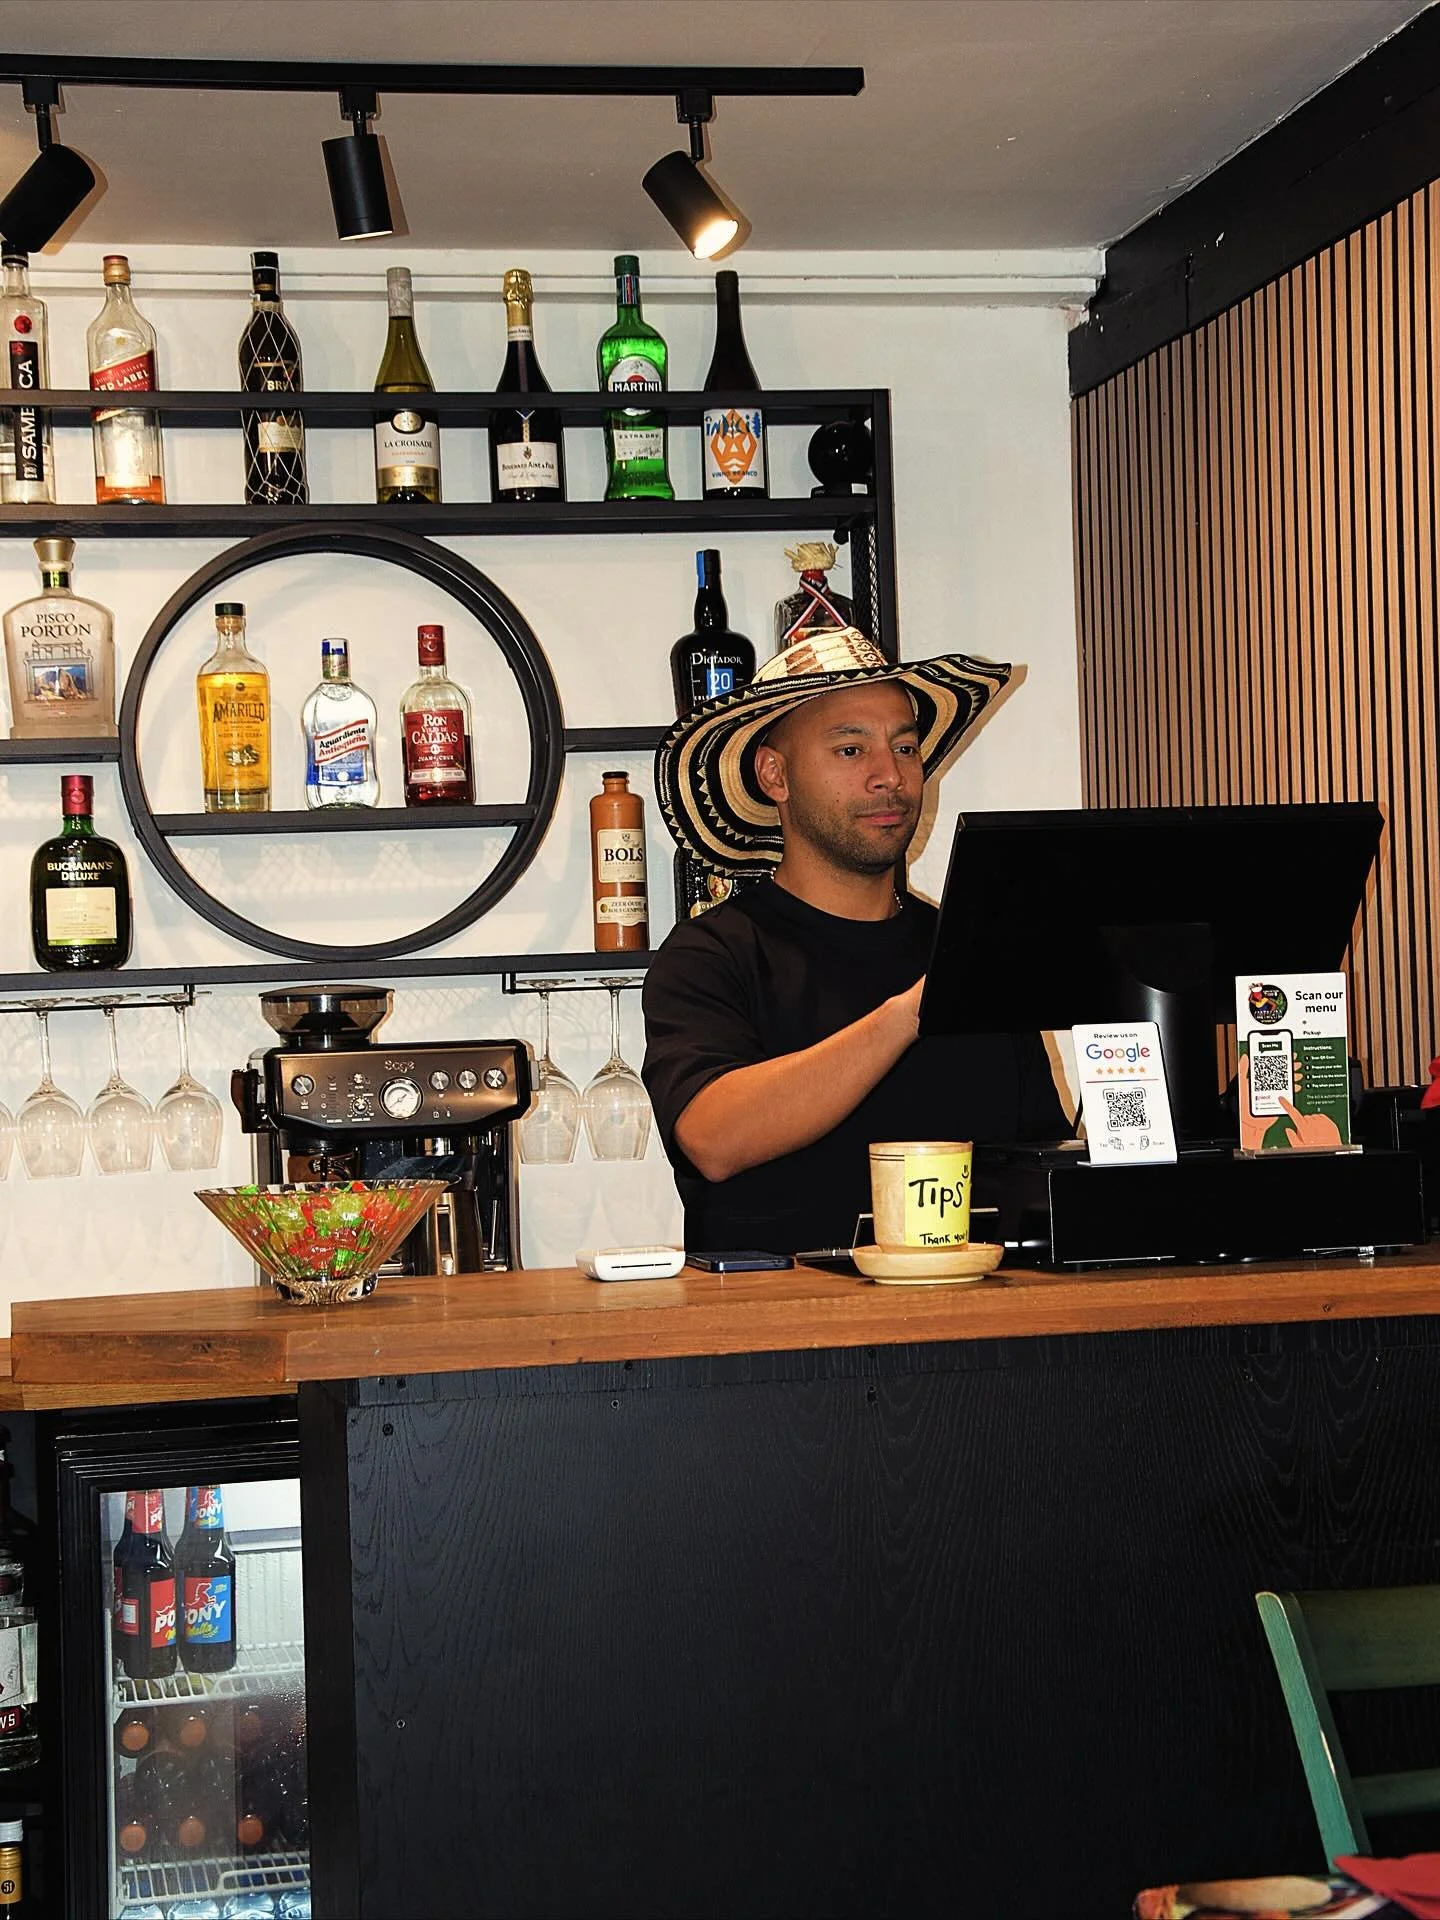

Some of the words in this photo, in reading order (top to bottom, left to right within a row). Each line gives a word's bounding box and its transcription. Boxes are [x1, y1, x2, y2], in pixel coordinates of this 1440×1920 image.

[116, 369, 149, 388] LABEL
[614, 382, 658, 393] MARTINI
[395, 440, 433, 448] CROISADE
[36, 613, 76, 624] PISCO
[710, 672, 731, 690] 20
[213, 702, 265, 723] AMARILLO
[320, 727, 366, 749] Aguardiente
[411, 731, 459, 745] CALDAS
[604, 847, 643, 862] BOLS
[47, 861, 113, 871] BUCHANAN'S
[61, 872, 100, 881] DELUXE
[1295, 991, 1322, 1001] Scan
[1324, 991, 1344, 1000] our
[1305, 1004, 1337, 1013] menu
[1086, 1042, 1151, 1062] Google
[909, 1178, 963, 1218] Tips
[919, 1232, 951, 1245] Thank
[184, 1600, 226, 1626] ONY
